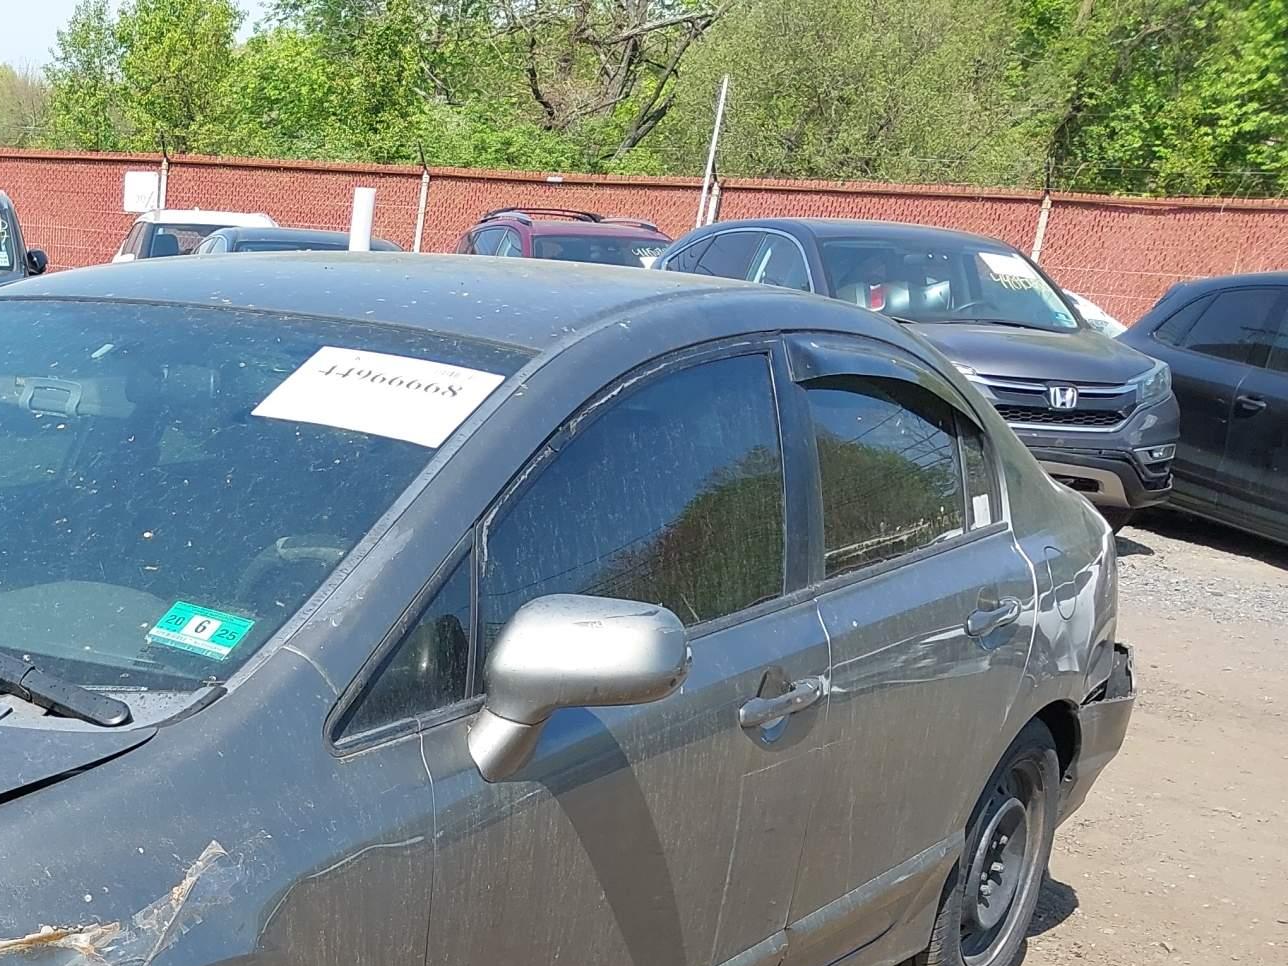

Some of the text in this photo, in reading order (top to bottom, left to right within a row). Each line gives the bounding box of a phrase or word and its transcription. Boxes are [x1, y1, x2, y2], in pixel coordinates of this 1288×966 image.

[318, 364, 463, 398] 44966668
[165, 614, 186, 626] 20
[194, 619, 211, 634] 6
[216, 628, 239, 641] 25
